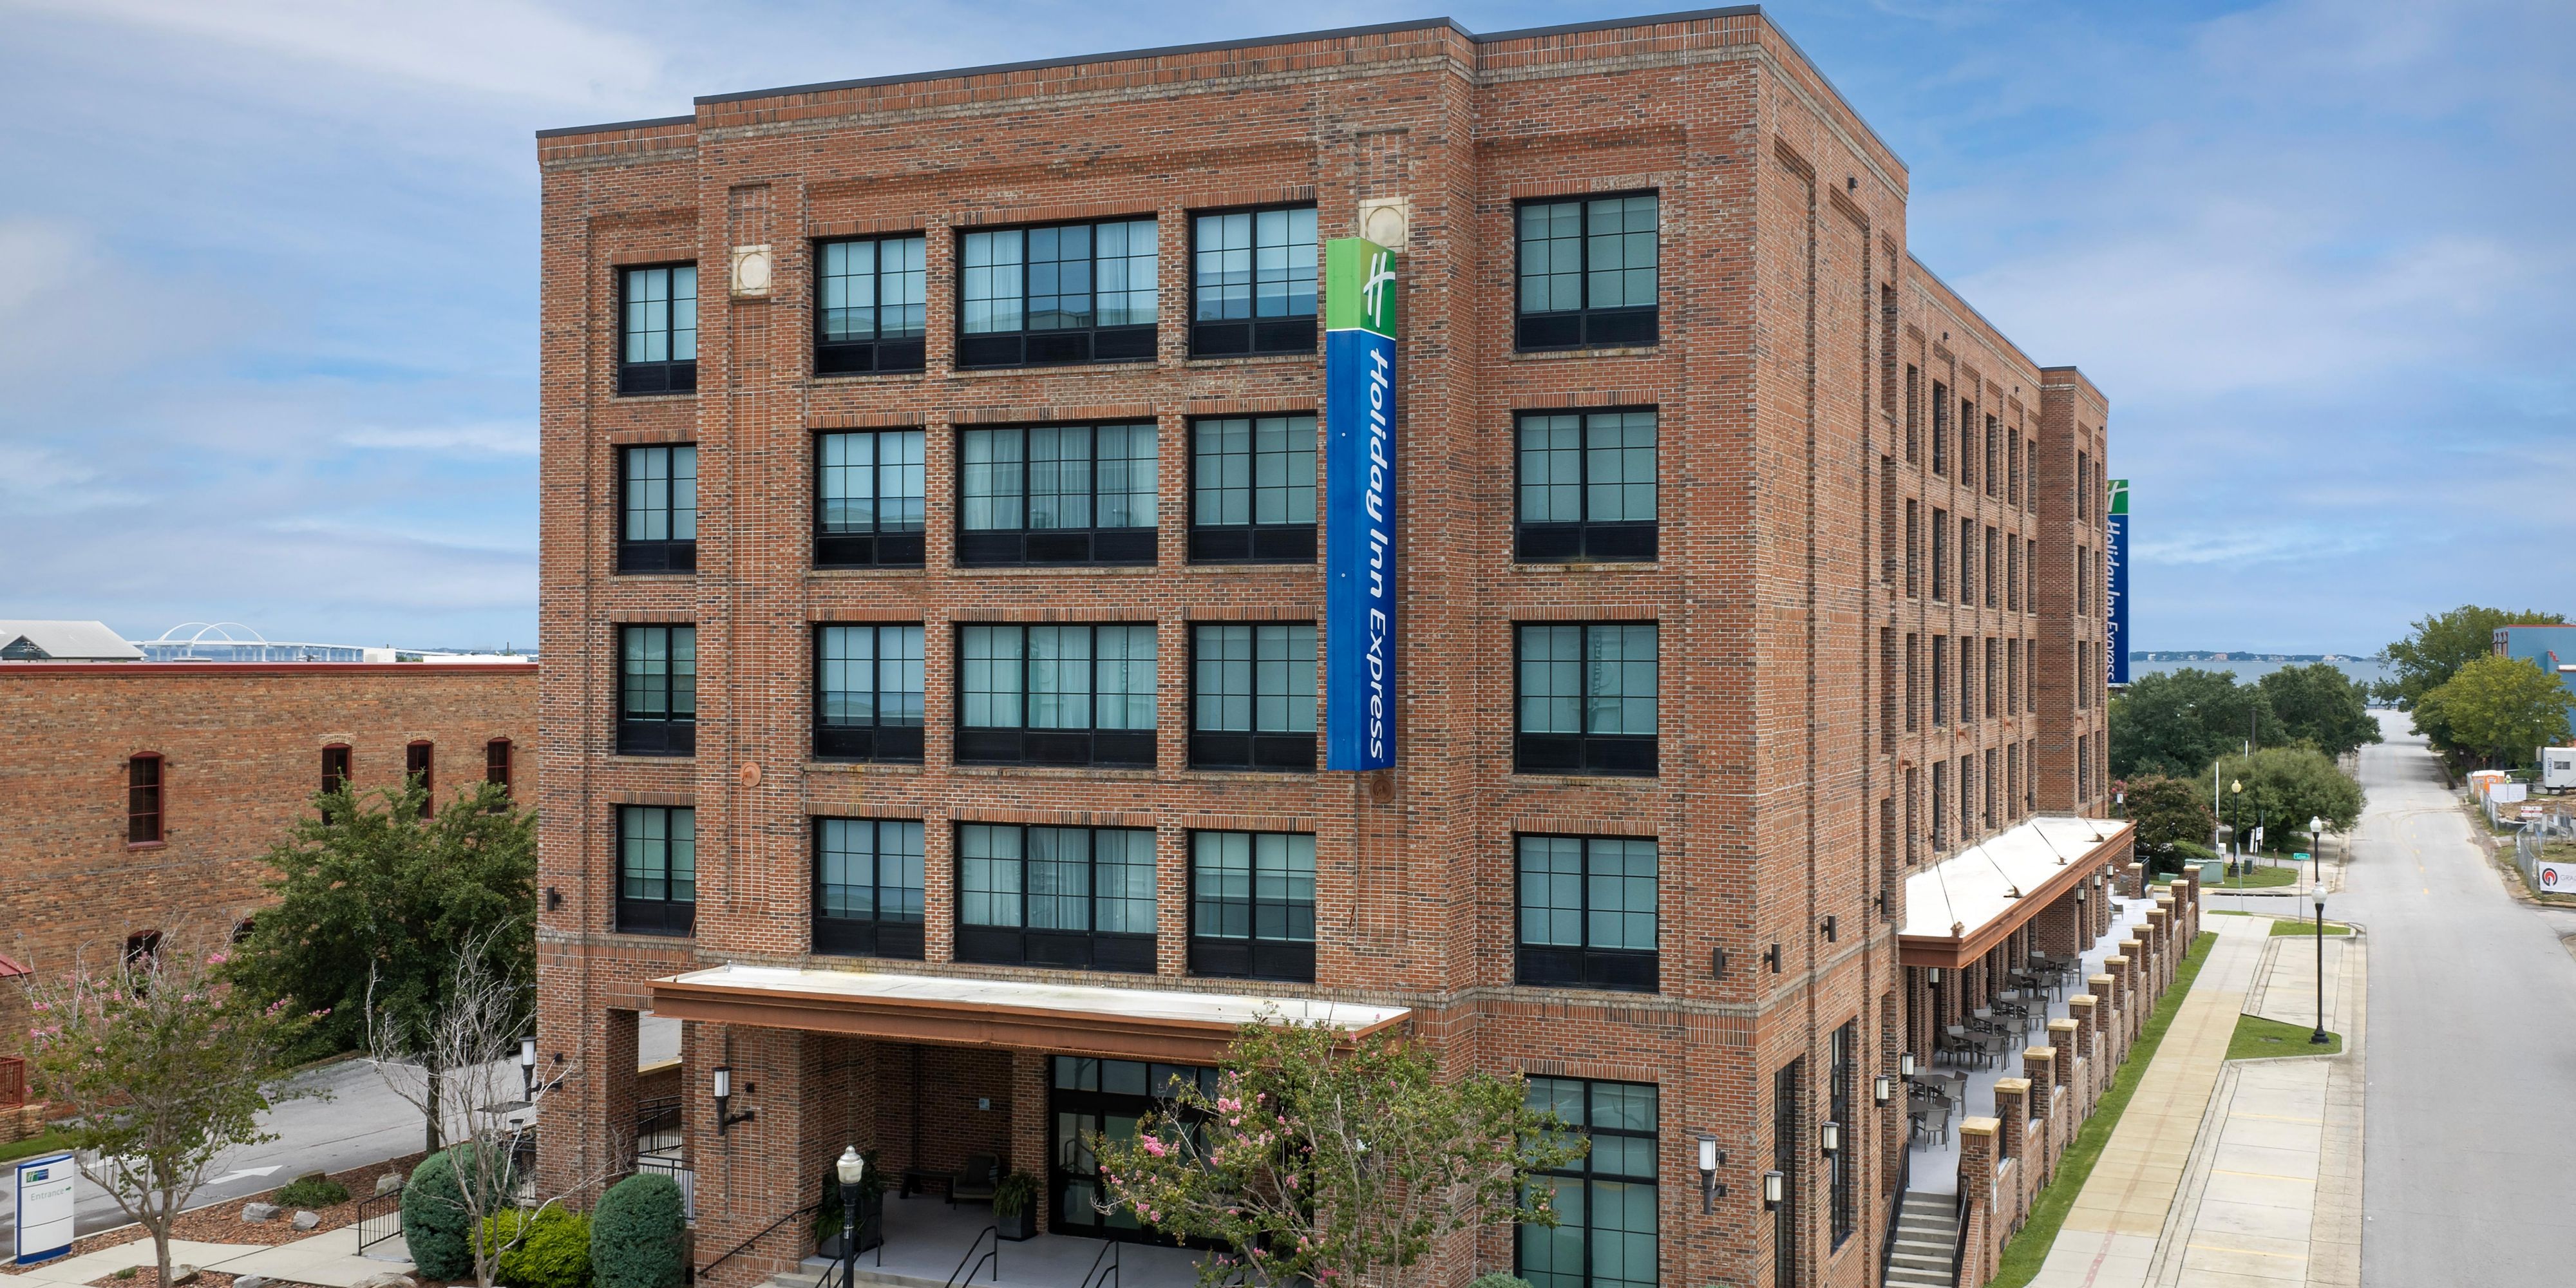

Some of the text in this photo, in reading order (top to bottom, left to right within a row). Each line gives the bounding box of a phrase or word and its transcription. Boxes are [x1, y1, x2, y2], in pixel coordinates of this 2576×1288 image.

[1366, 348, 1388, 759] Holiday Inn Express
[31, 1189, 64, 1200] Entrance
